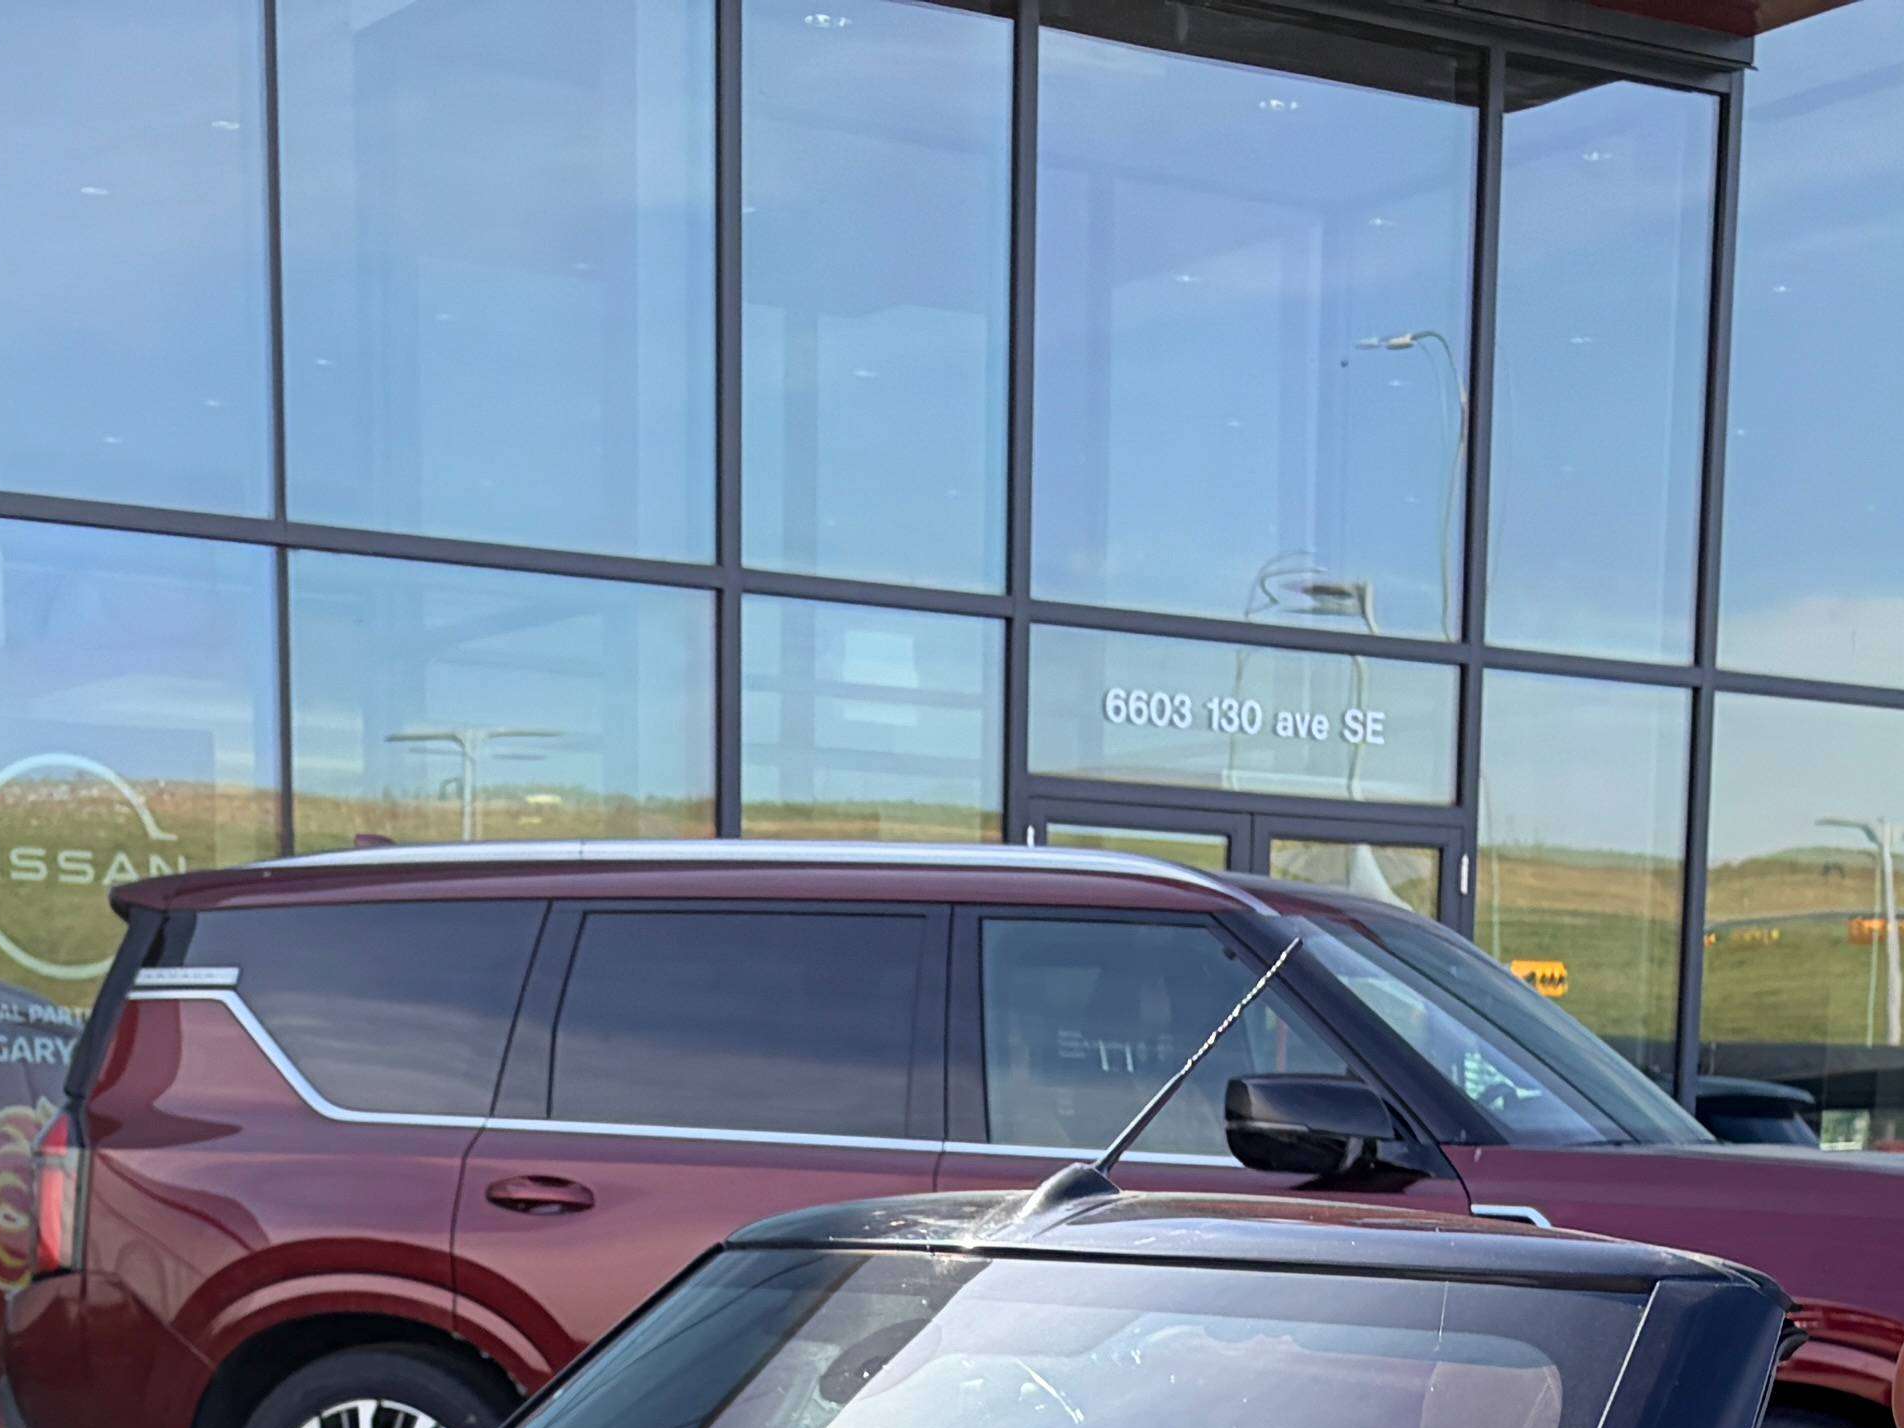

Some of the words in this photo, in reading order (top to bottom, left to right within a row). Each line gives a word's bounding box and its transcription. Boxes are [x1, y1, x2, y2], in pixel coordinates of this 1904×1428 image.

[1104, 687, 1193, 729] 6603
[1206, 697, 1263, 735] 130
[1276, 710, 1330, 740] ave
[1342, 708, 1386, 745] SE
